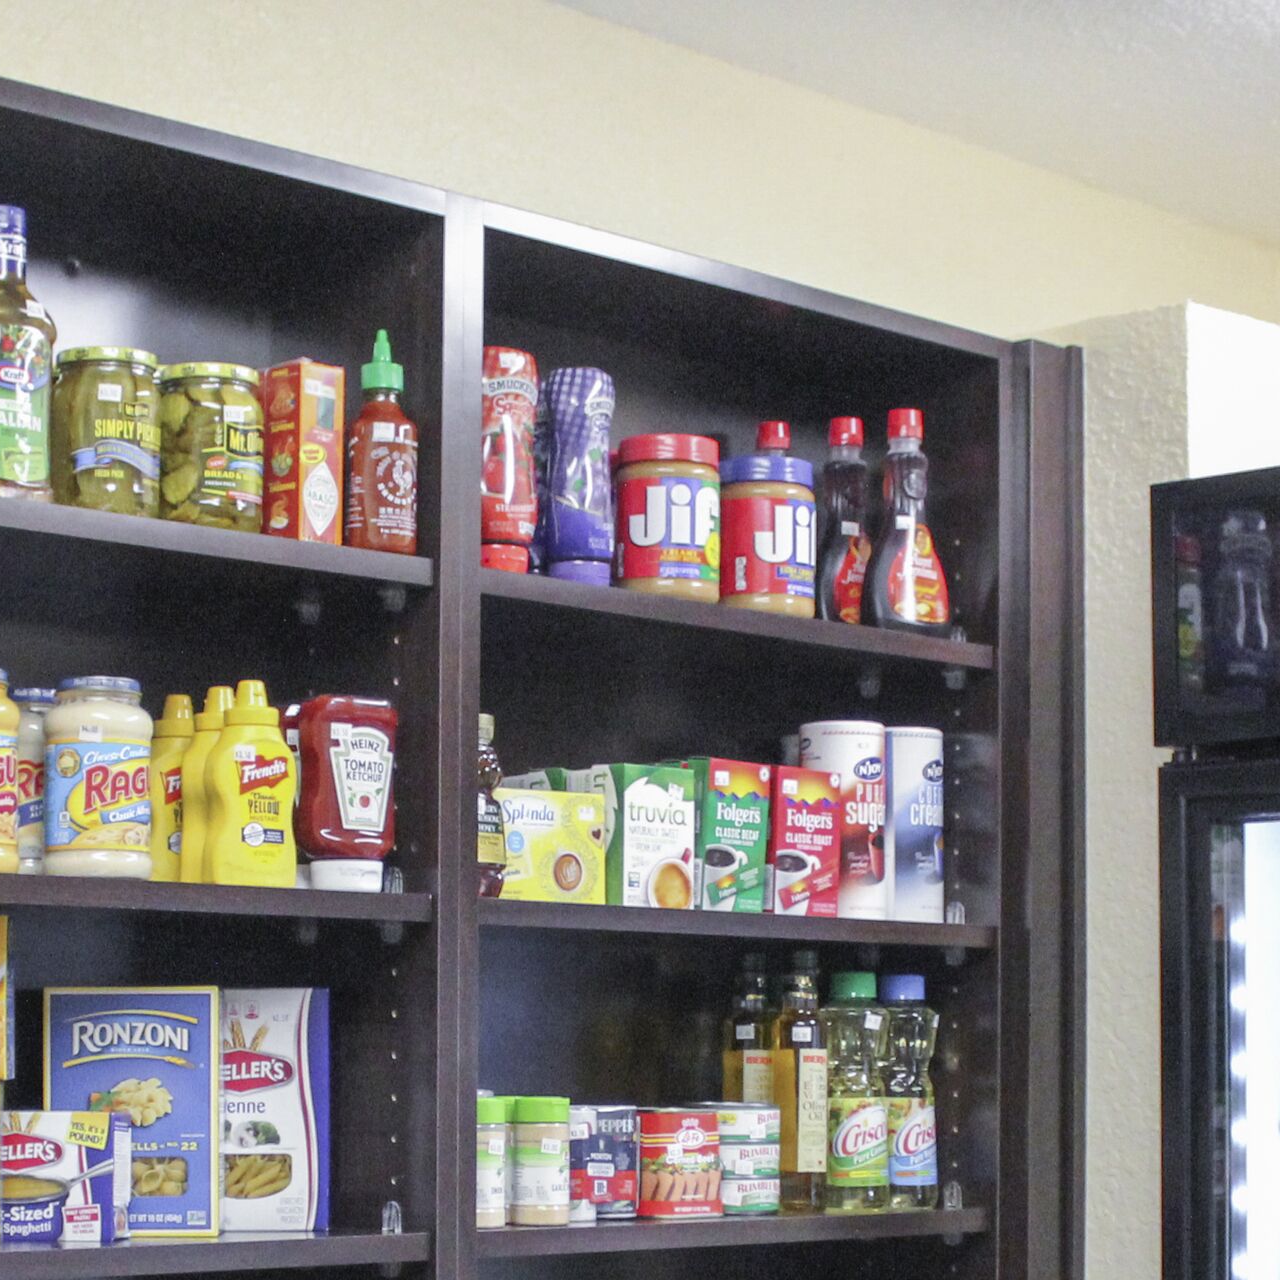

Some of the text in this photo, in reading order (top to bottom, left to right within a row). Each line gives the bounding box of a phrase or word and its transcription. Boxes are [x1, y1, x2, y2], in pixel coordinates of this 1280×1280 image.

[94, 419, 135, 440] SIMPLY
[350, 738, 381, 753] HEINZ
[242, 758, 288, 781] French's
[344, 758, 384, 774] TOMATO
[346, 770, 384, 784] KETCHUP
[109, 807, 134, 822] Classic
[248, 799, 280, 816] YELLOW
[716, 802, 761, 826] Folgers
[786, 809, 833, 833] Folgers
[72, 1020, 190, 1056] RONZONI
[3, 1219, 52, 1236] Spaghetti
